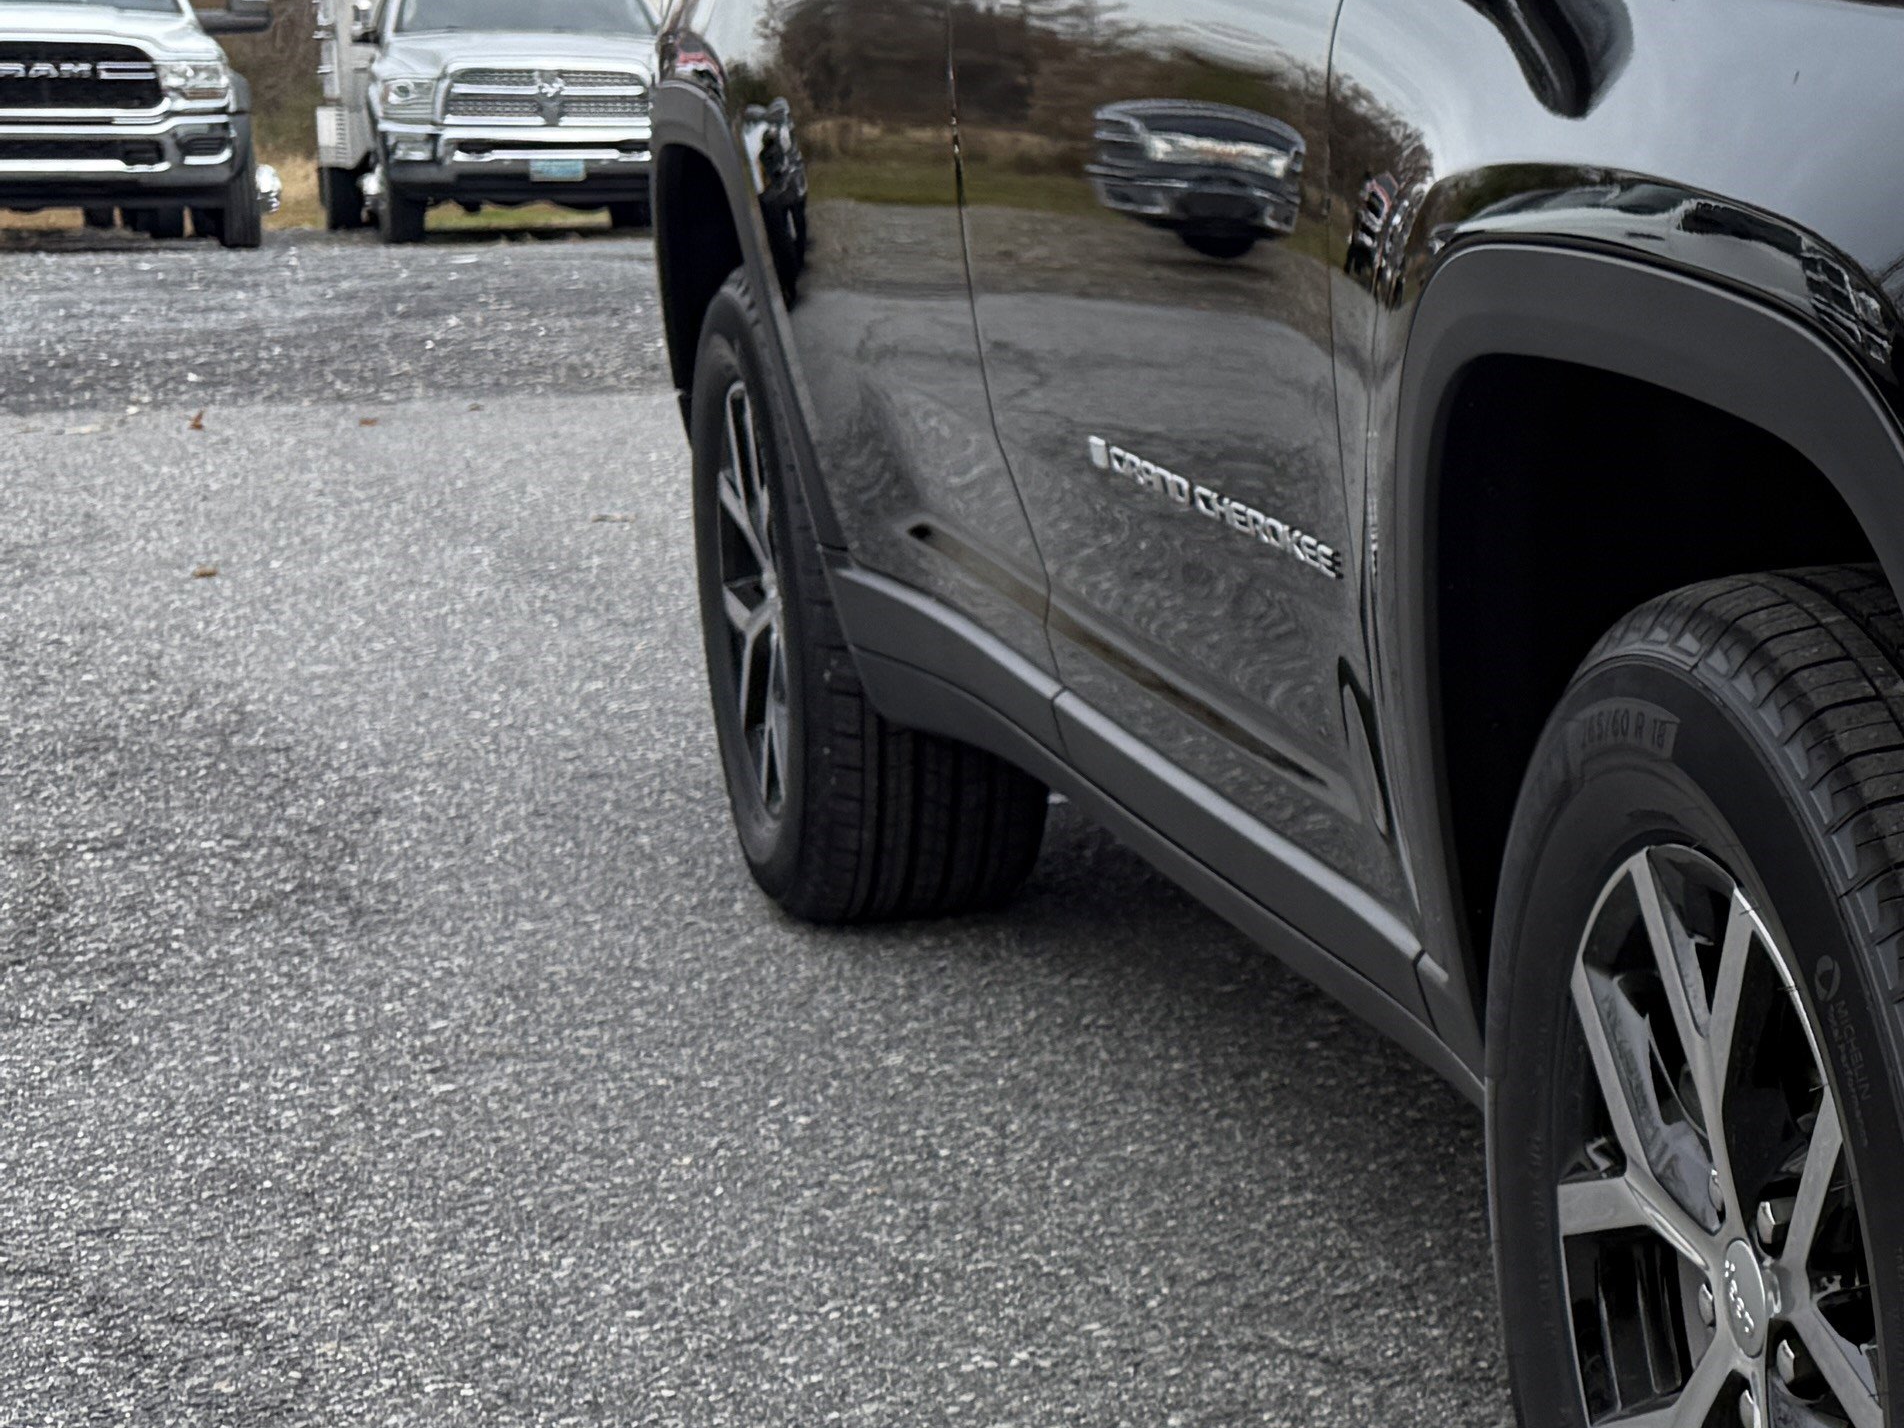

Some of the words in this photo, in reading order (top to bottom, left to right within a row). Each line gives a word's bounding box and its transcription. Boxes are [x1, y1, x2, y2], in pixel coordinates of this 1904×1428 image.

[1109, 445, 1192, 505] GRAND
[1193, 484, 1344, 580] CHEROKEE
[1836, 999, 1872, 1102] MICHELIN
